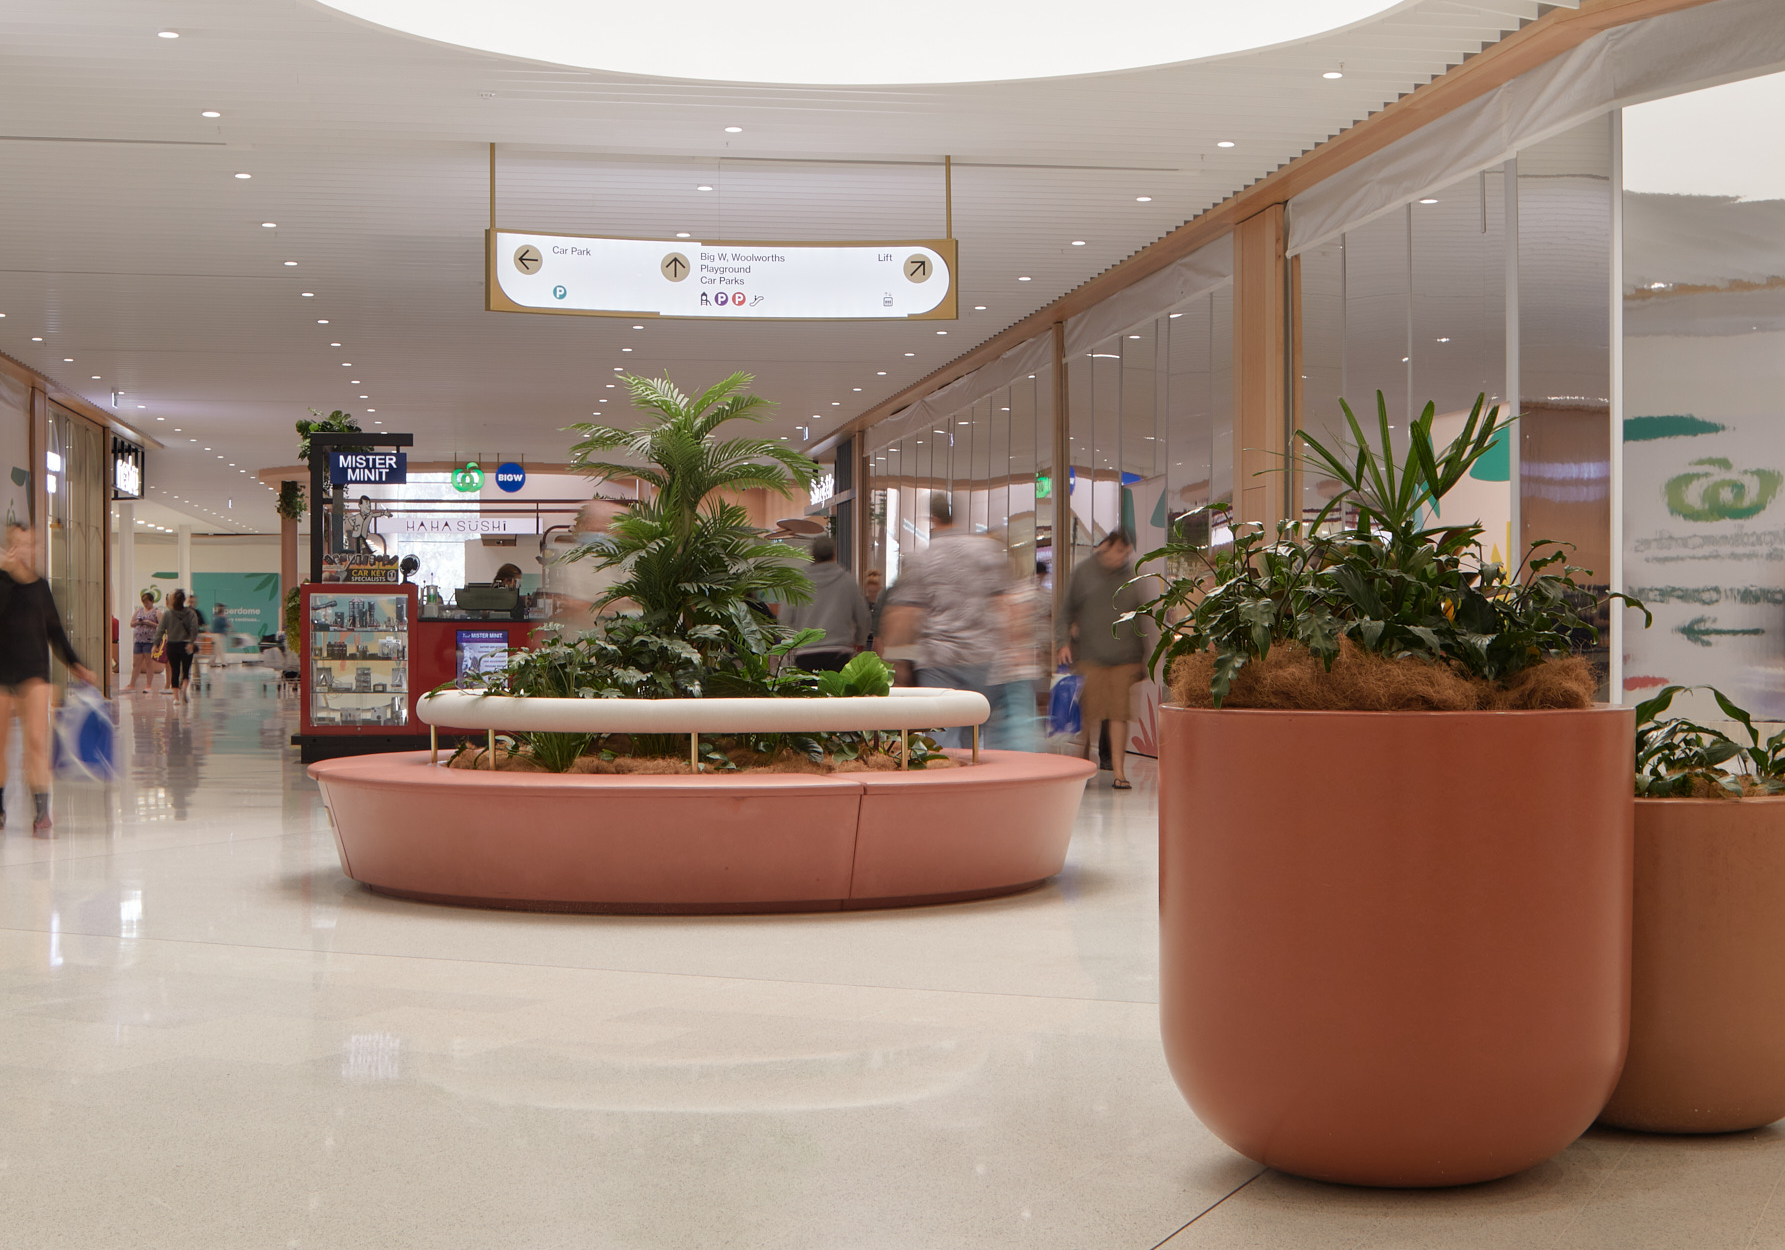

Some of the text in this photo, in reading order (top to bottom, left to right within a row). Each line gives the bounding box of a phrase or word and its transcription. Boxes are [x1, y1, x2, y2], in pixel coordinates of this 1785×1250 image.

[552, 245, 592, 256] Car Park
[700, 252, 786, 263] Big W, Woolworths
[878, 253, 893, 262] Lift
[700, 264, 751, 275] Playground
[700, 276, 745, 286] Car Parks
[339, 455, 397, 468] MISTER
[347, 469, 389, 481] MINIT
[406, 520, 452, 531] HAHA
[352, 569, 386, 577] CAR KEY
[212, 606, 260, 615] Hperdome
